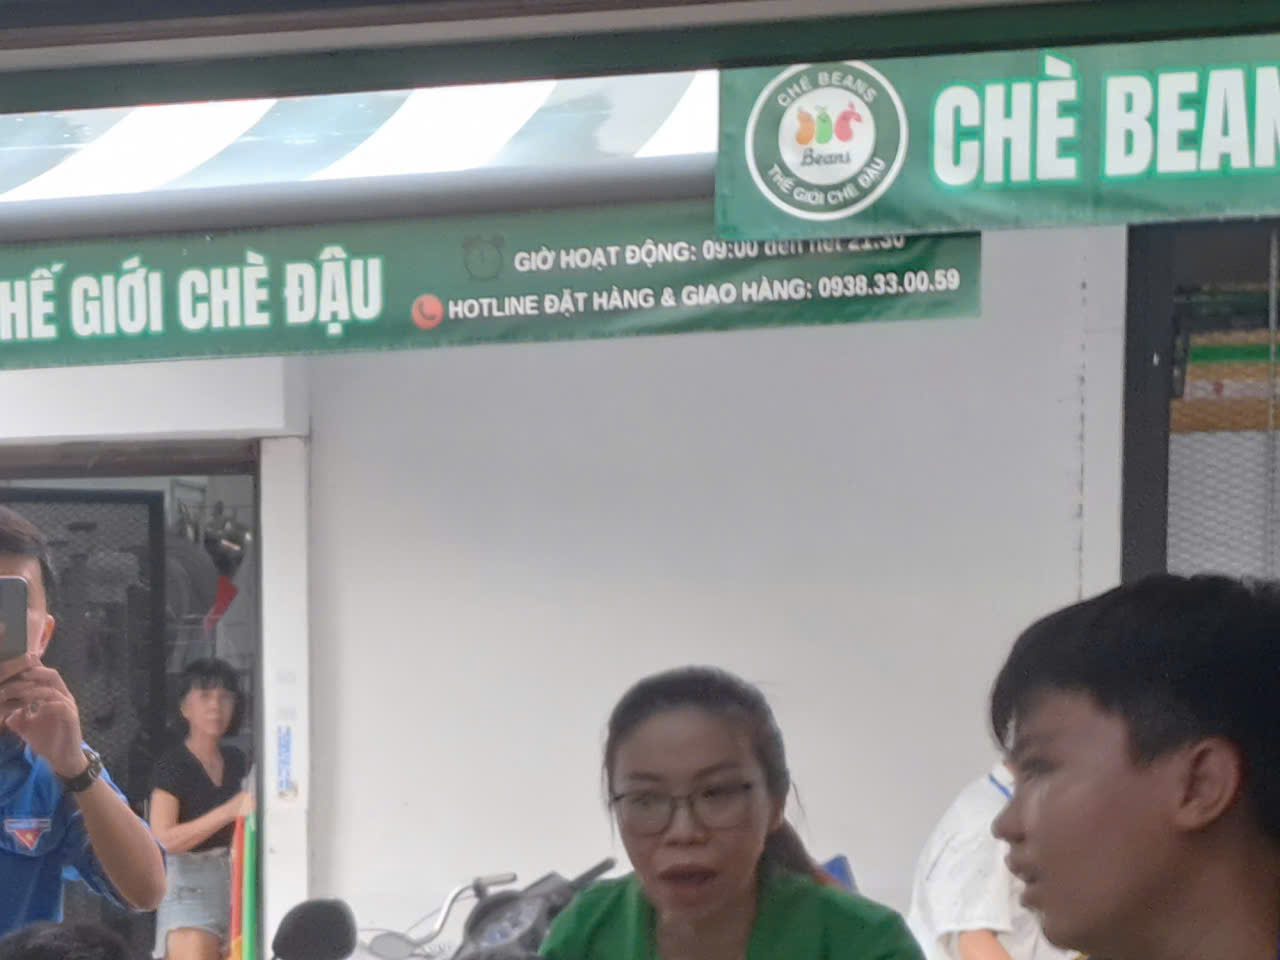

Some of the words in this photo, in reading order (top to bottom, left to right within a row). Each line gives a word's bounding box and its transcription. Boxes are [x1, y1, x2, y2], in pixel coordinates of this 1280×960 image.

[933, 55, 1079, 187] CHÈ
[70, 255, 164, 336] GIỚI
[178, 250, 271, 330] CHÈ
[284, 245, 382, 335] ĐẬU
[514, 246, 556, 272] GIỜ
[560, 246, 620, 271] HOẠT
[625, 239, 697, 270] ĐỘNG:
[702, 239, 760, 260] 09:00
[448, 294, 539, 319] HOTLINE
[544, 289, 588, 317] ĐẶT
[592, 286, 655, 312] HÀNG
[660, 286, 676, 307] &
[681, 281, 737, 306] GIAO
[741, 276, 813, 303] HÀNG:
[818, 268, 961, 299] 0938.33.00.59
